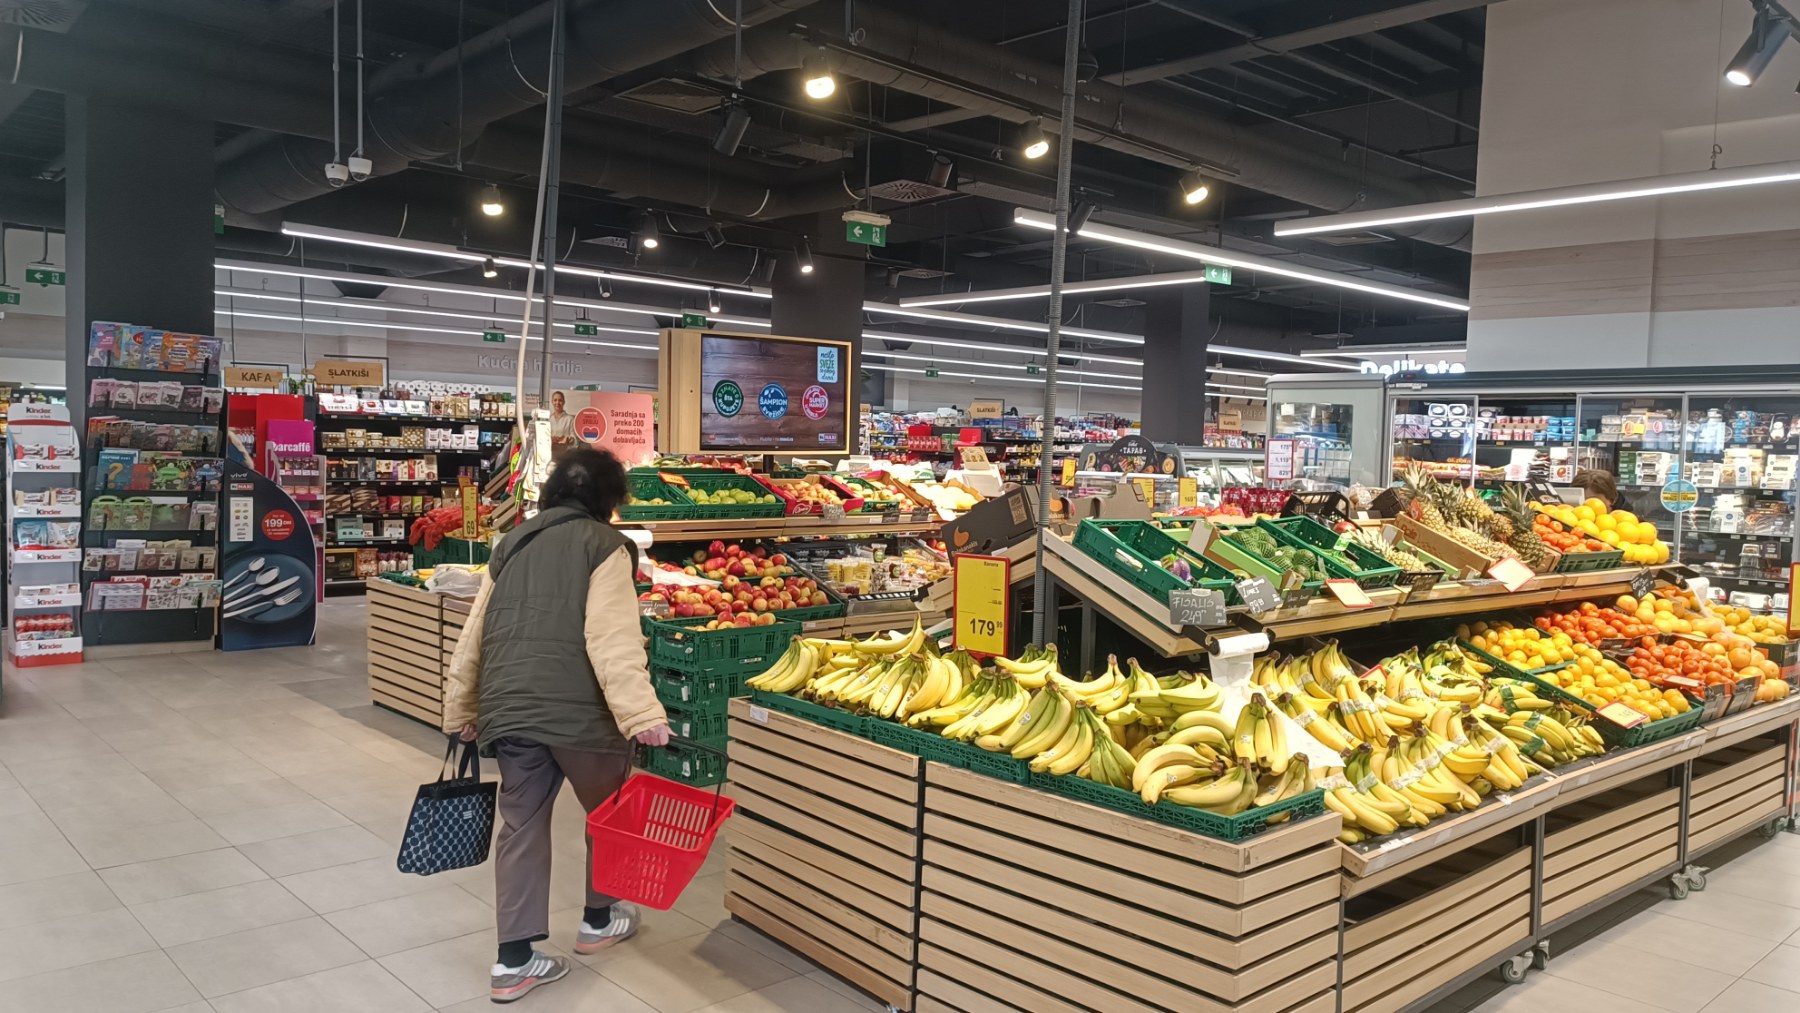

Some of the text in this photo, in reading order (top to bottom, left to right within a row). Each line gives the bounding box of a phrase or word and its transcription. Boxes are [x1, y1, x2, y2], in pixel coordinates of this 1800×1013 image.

[533, 358, 583, 376] hmija
[241, 372, 272, 382] KAFA
[328, 368, 369, 378] SLATKIŠI
[759, 396, 788, 406] ŠAMPION
[610, 409, 638, 419] Saradnja
[613, 419, 632, 427] preko
[616, 428, 643, 436] domaćih
[1122, 446, 1143, 454] TAPAS
[264, 518, 283, 527] 199
[466, 520, 475, 535] 69
[1172, 597, 1214, 608] FISALIS
[1179, 609, 1202, 624] 249
[969, 618, 996, 636] 179
